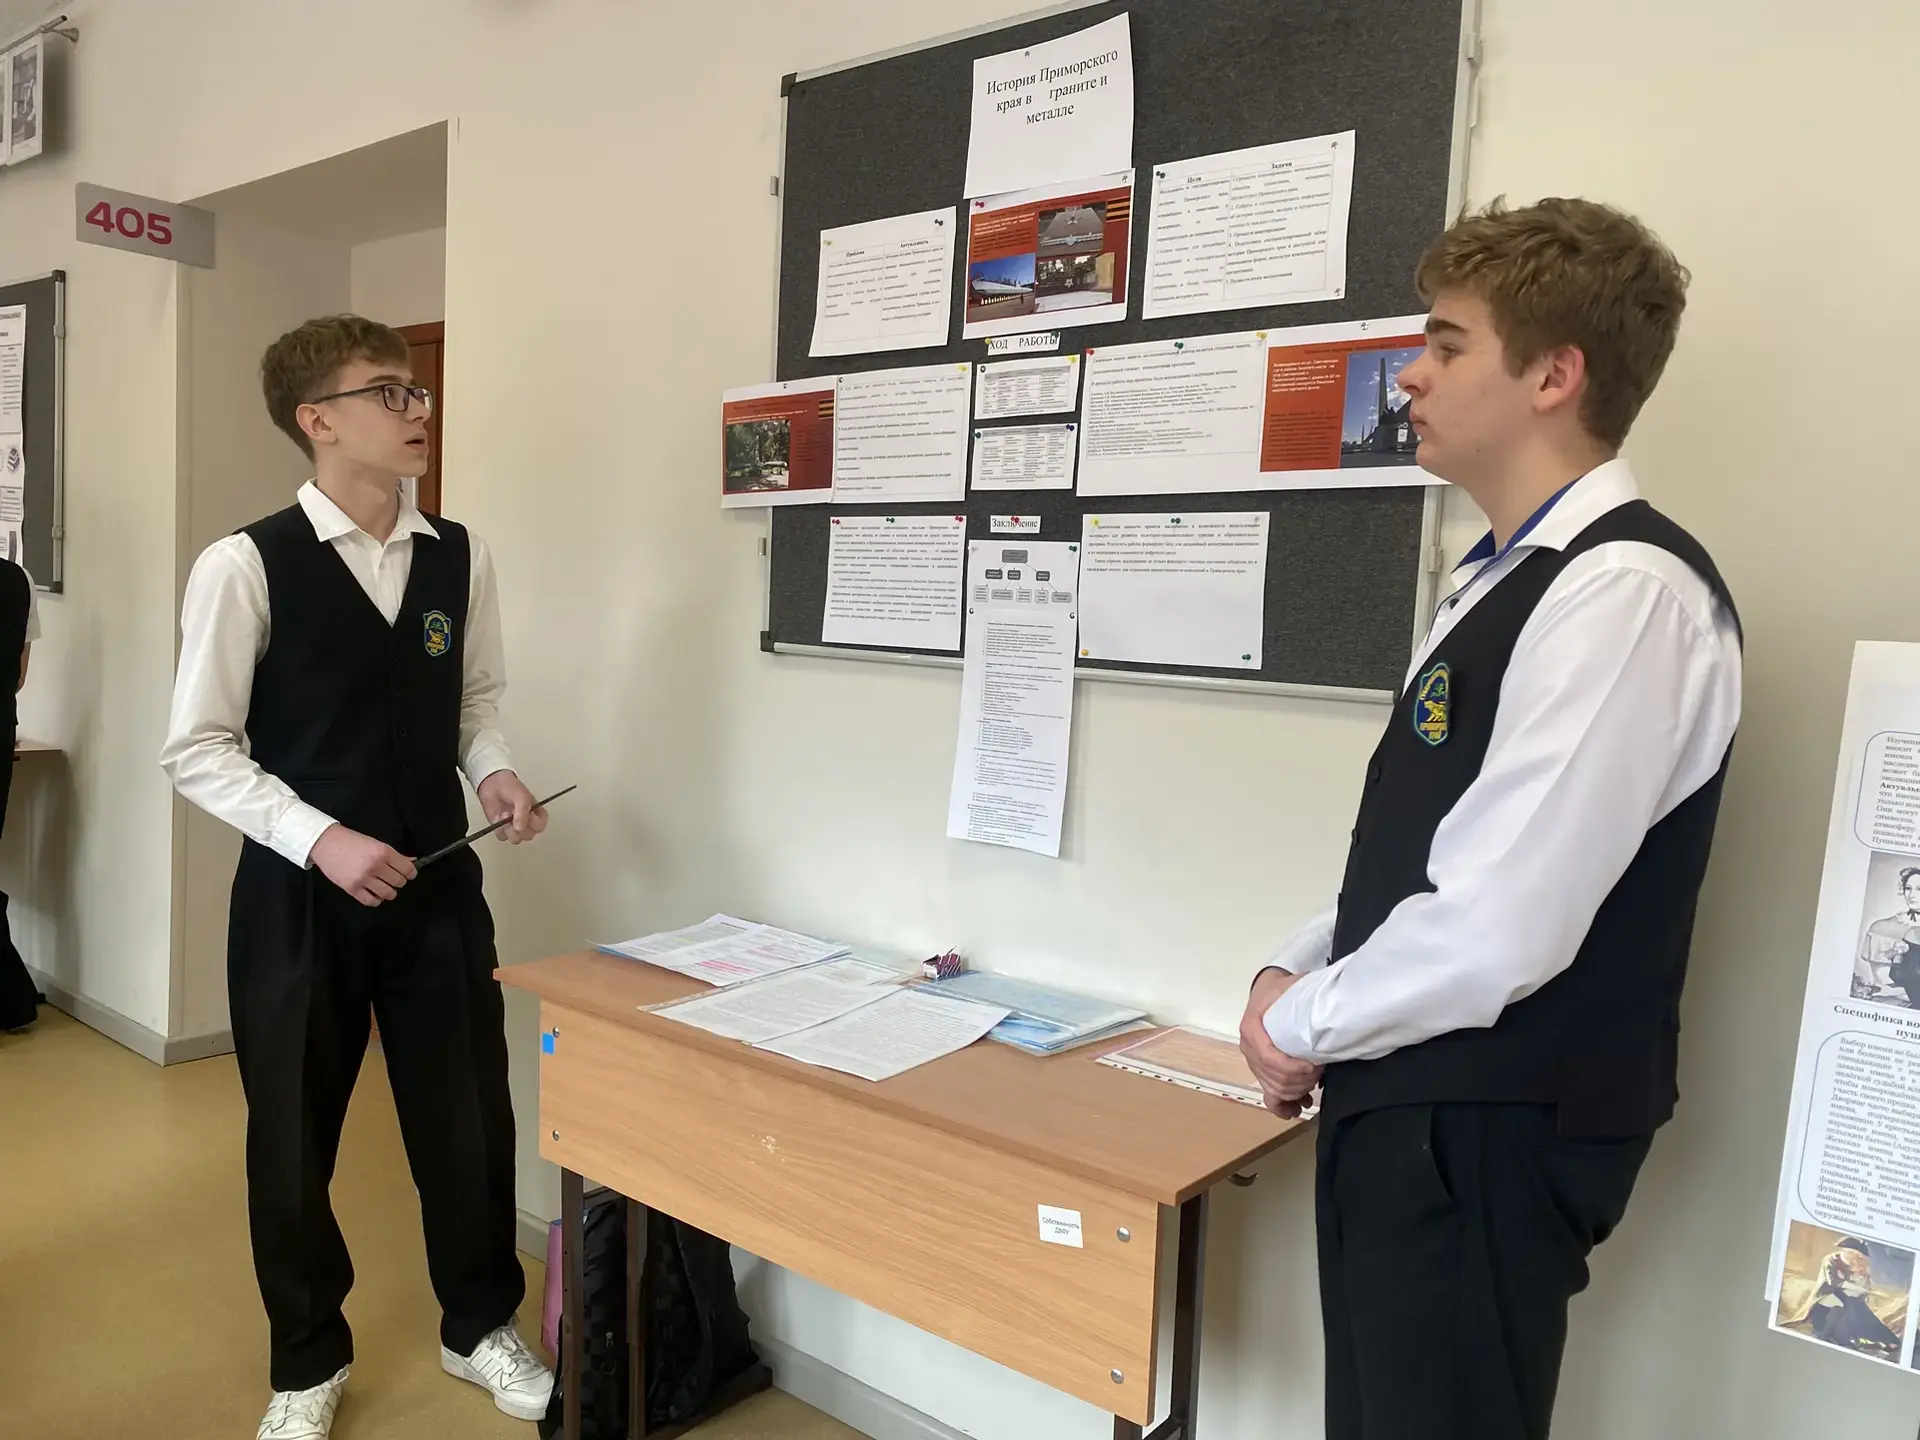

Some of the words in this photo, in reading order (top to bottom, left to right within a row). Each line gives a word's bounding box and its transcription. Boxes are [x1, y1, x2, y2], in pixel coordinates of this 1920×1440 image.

[986, 72, 1036, 96] История
[1039, 50, 1118, 84] Приморского
[996, 96, 1022, 114] края
[1025, 95, 1032, 105] в
[1049, 78, 1097, 101] граните
[1100, 75, 1108, 87] и
[1026, 104, 1075, 124] металле
[85, 201, 173, 245] 405
[990, 339, 1008, 350] ХОД
[1019, 336, 1057, 347] РАБОТЫ
[1834, 1004, 1903, 1026] Специфика
